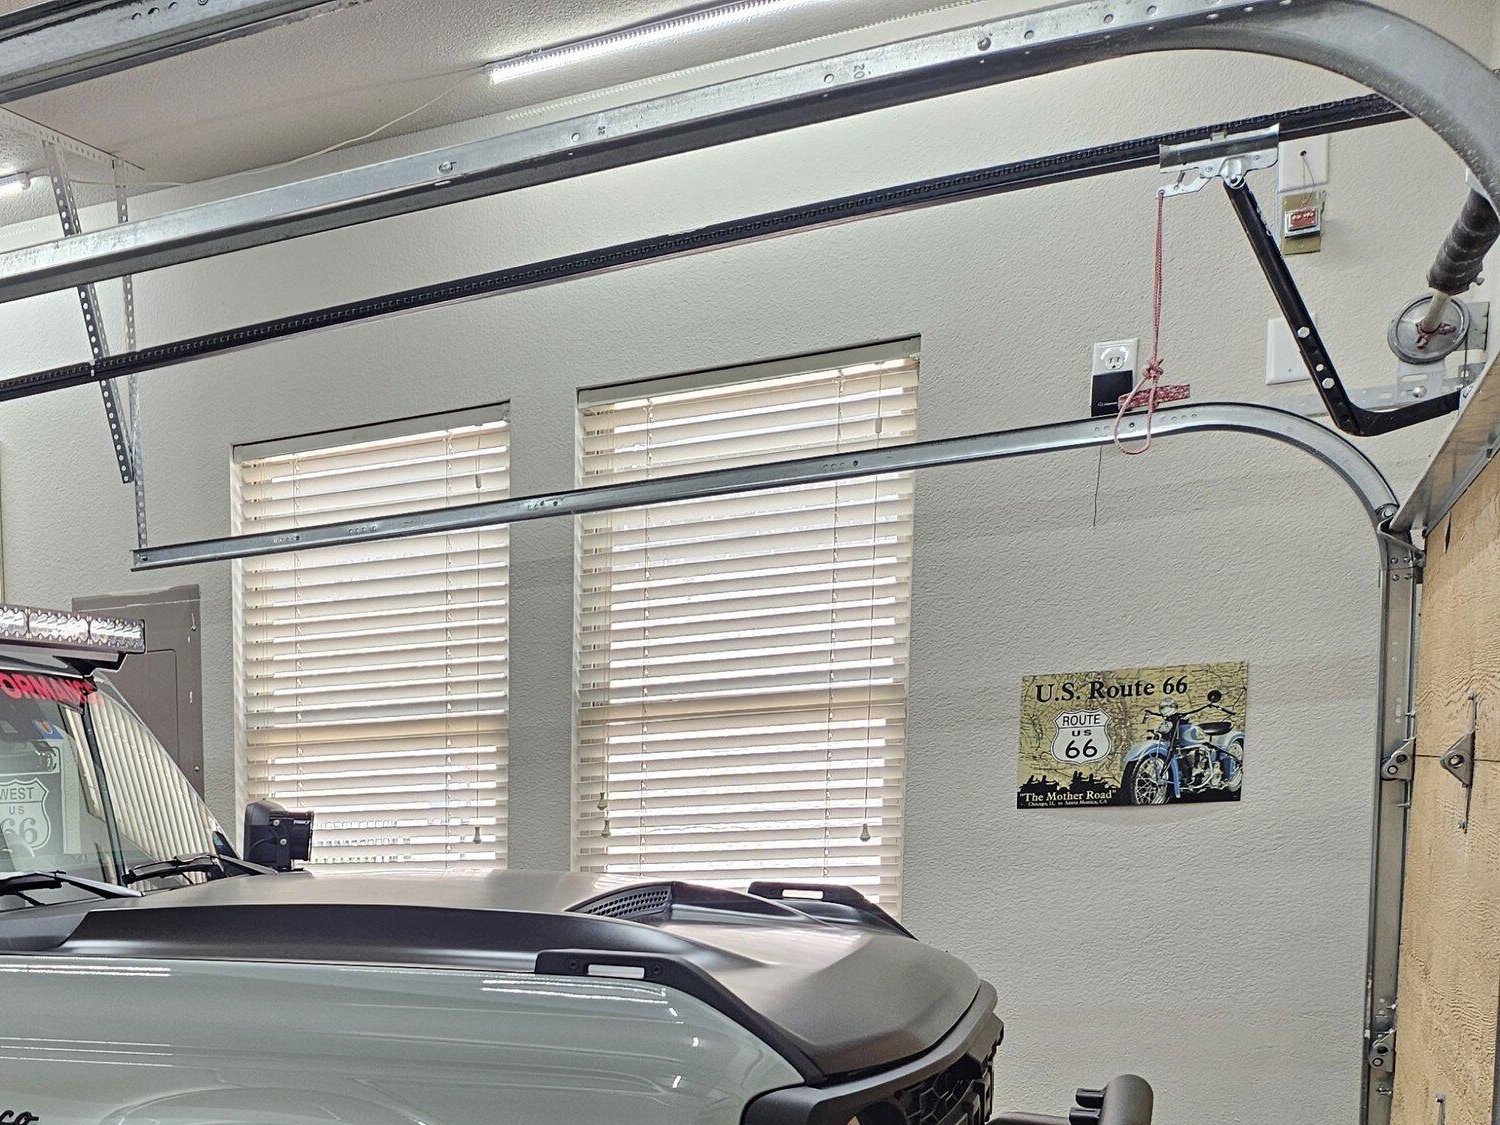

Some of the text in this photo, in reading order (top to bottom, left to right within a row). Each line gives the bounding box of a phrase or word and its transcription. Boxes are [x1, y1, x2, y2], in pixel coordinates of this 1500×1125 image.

[1035, 675, 1188, 703] U.S. Route 66
[1062, 713, 1101, 726] ROUTE
[1071, 729, 1092, 737] US
[1065, 738, 1098, 759] 66
[1046, 791, 1084, 801] Mother
[8, 805, 25, 815] US
[0, 817, 38, 844] 66
